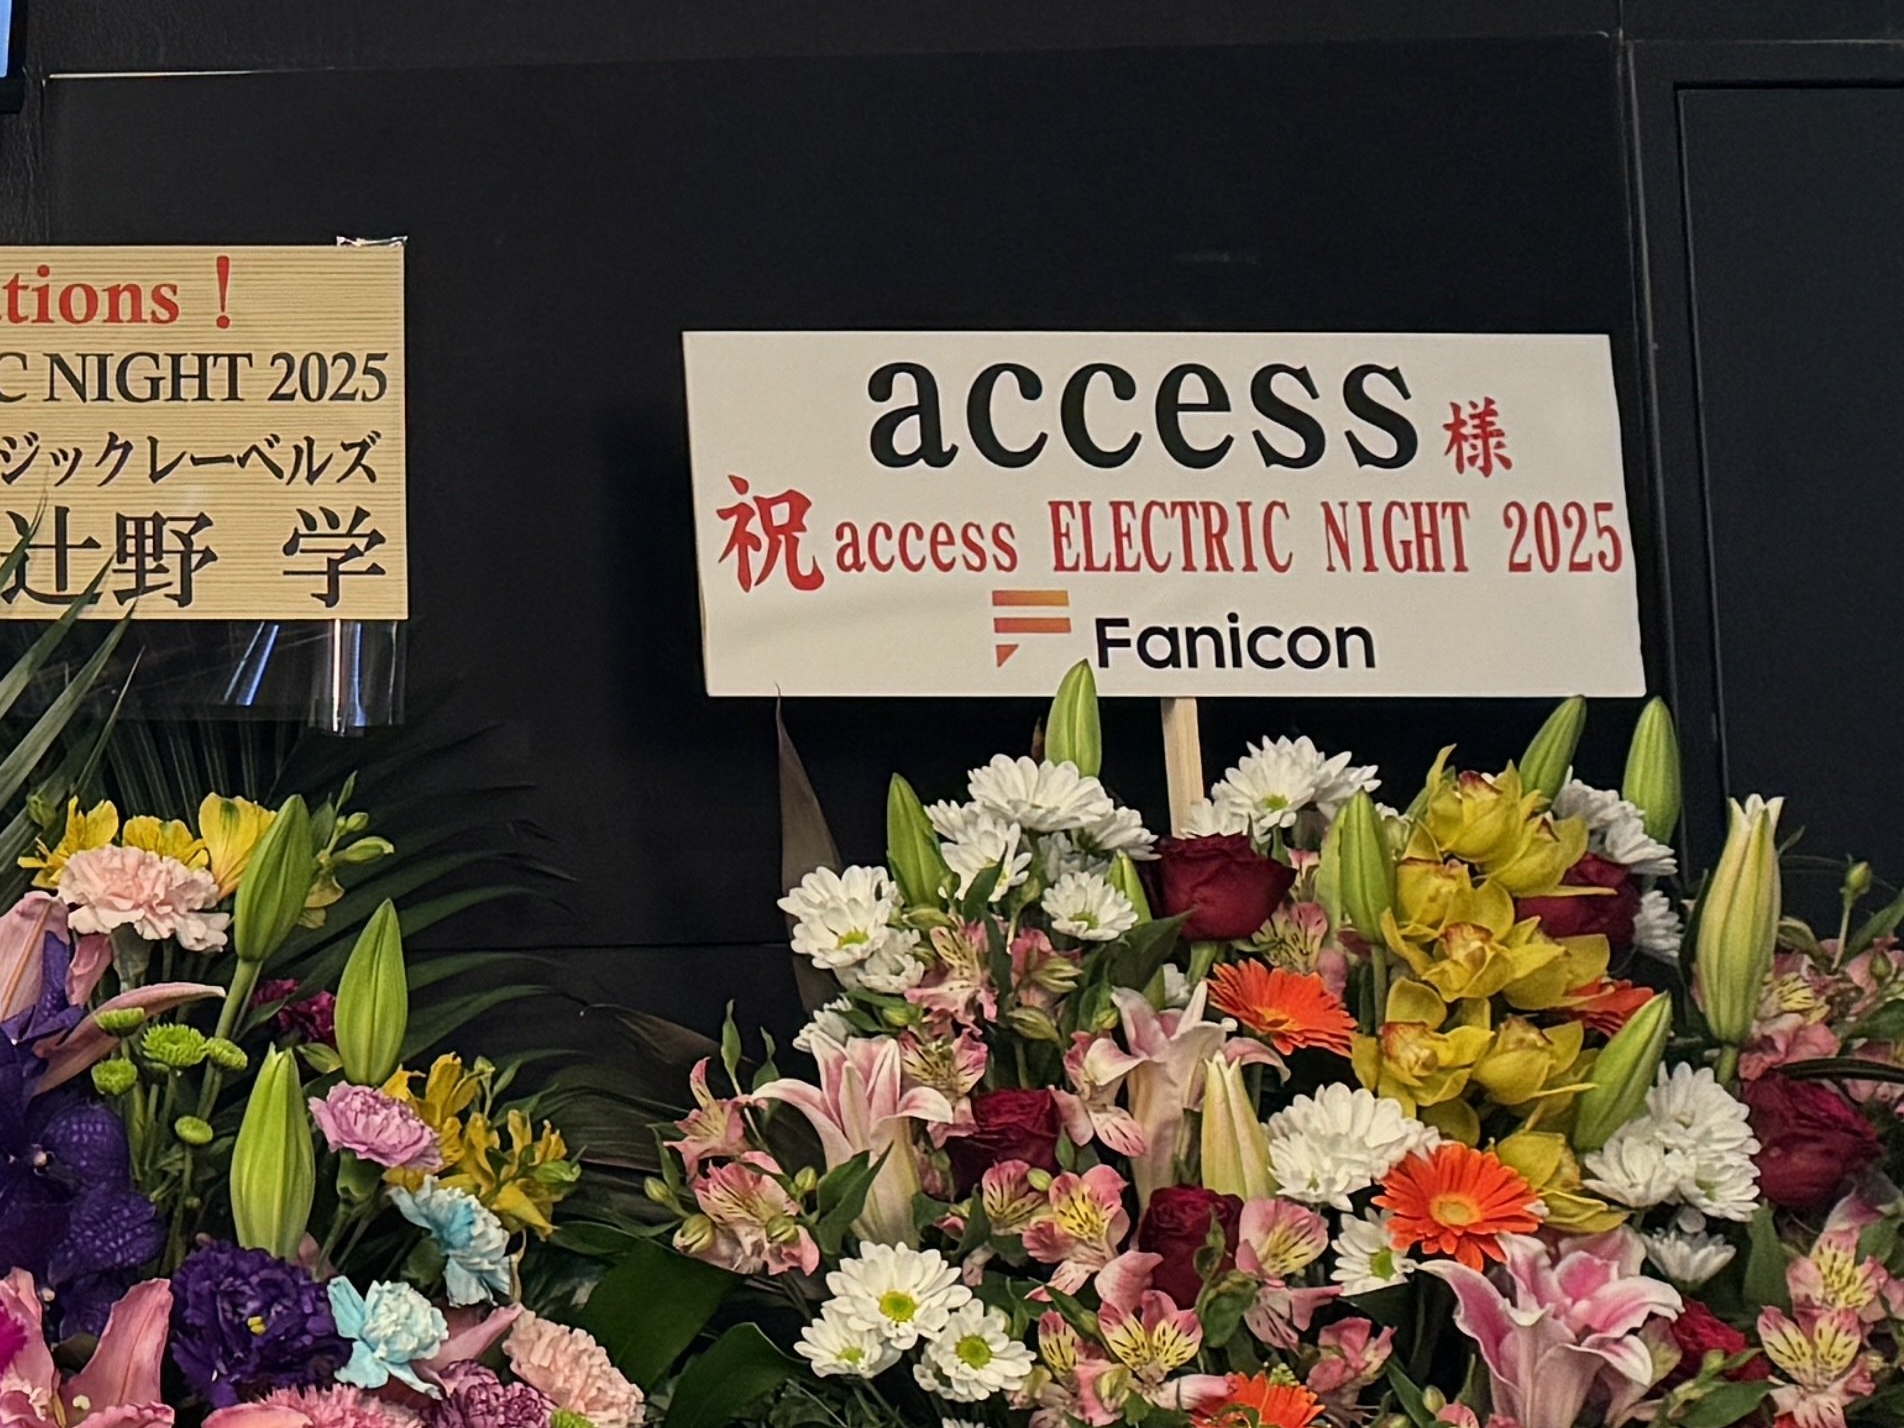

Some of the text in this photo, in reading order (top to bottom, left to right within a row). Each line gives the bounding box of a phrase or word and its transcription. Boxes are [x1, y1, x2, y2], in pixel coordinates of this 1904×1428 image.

[42, 351, 254, 403] NIGHT
[267, 351, 389, 403] 2025
[867, 358, 1512, 476] access 様
[282, 505, 386, 608] 学
[718, 476, 1624, 592] 祝 access ELECTRIC NIGHT 2025
[1093, 612, 1376, 672] Fanicon
